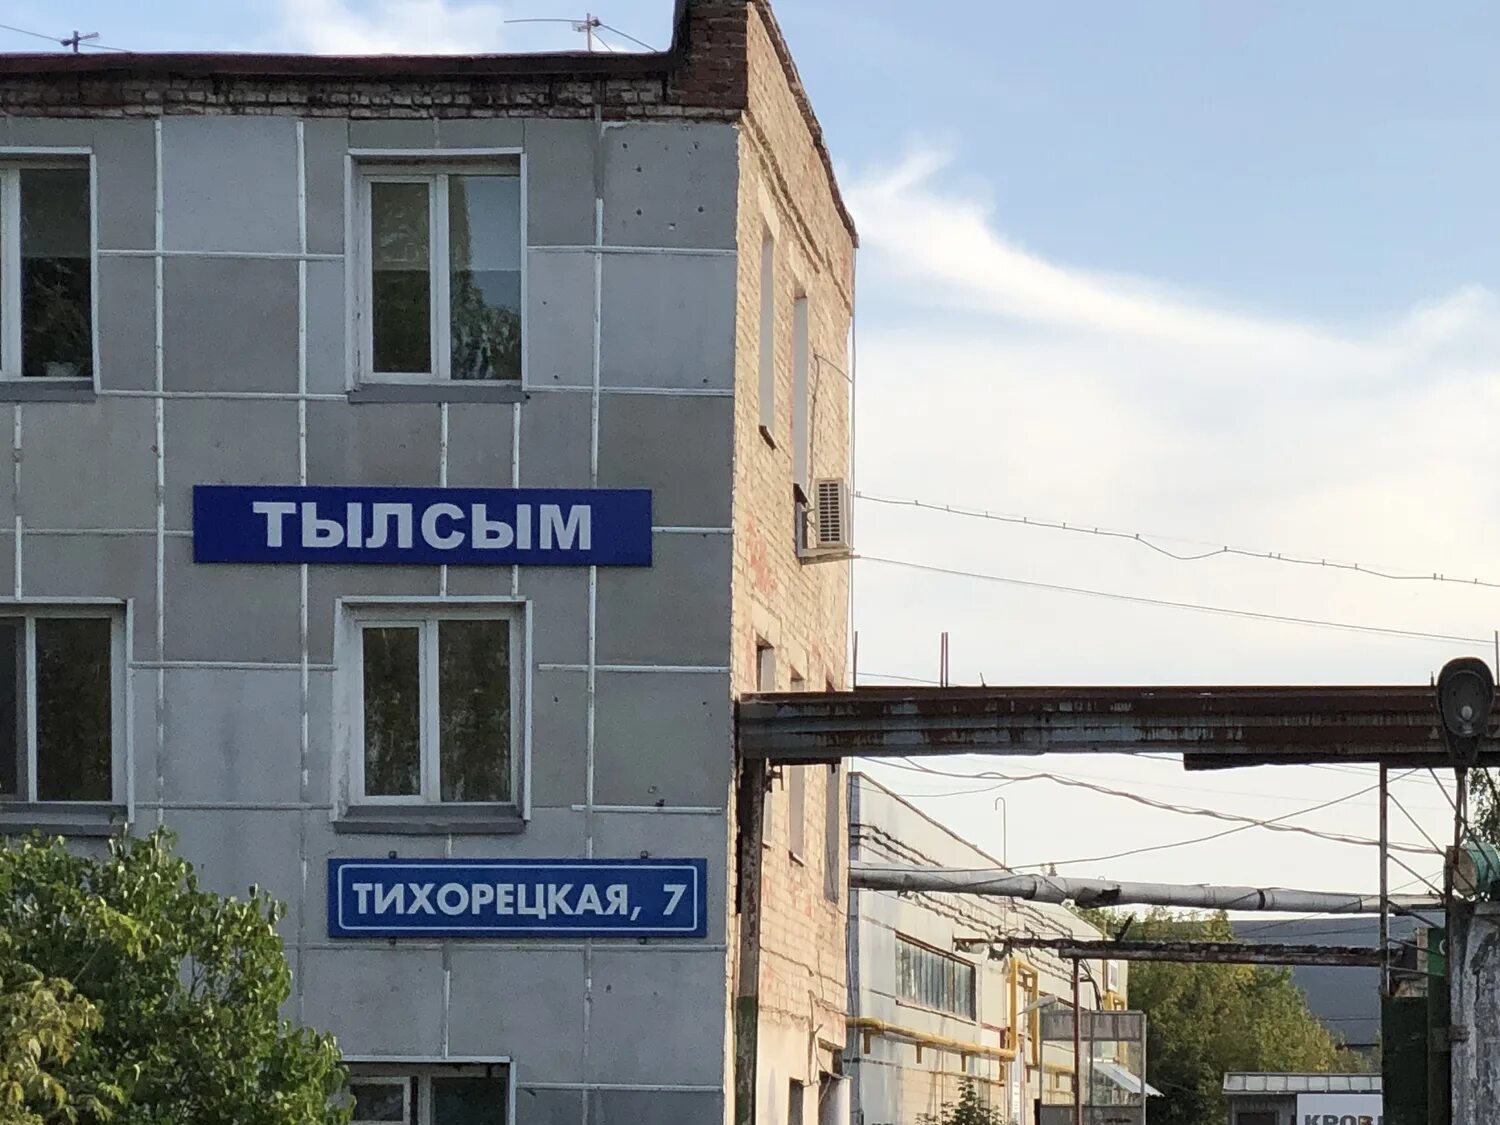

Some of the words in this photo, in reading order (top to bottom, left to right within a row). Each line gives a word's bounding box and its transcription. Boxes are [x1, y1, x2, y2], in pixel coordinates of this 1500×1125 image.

[252, 501, 592, 551] ТЫЛСЫМ
[353, 882, 641, 922] ТИХОРЕЦКАЯ,
[663, 884, 689, 915] 7
